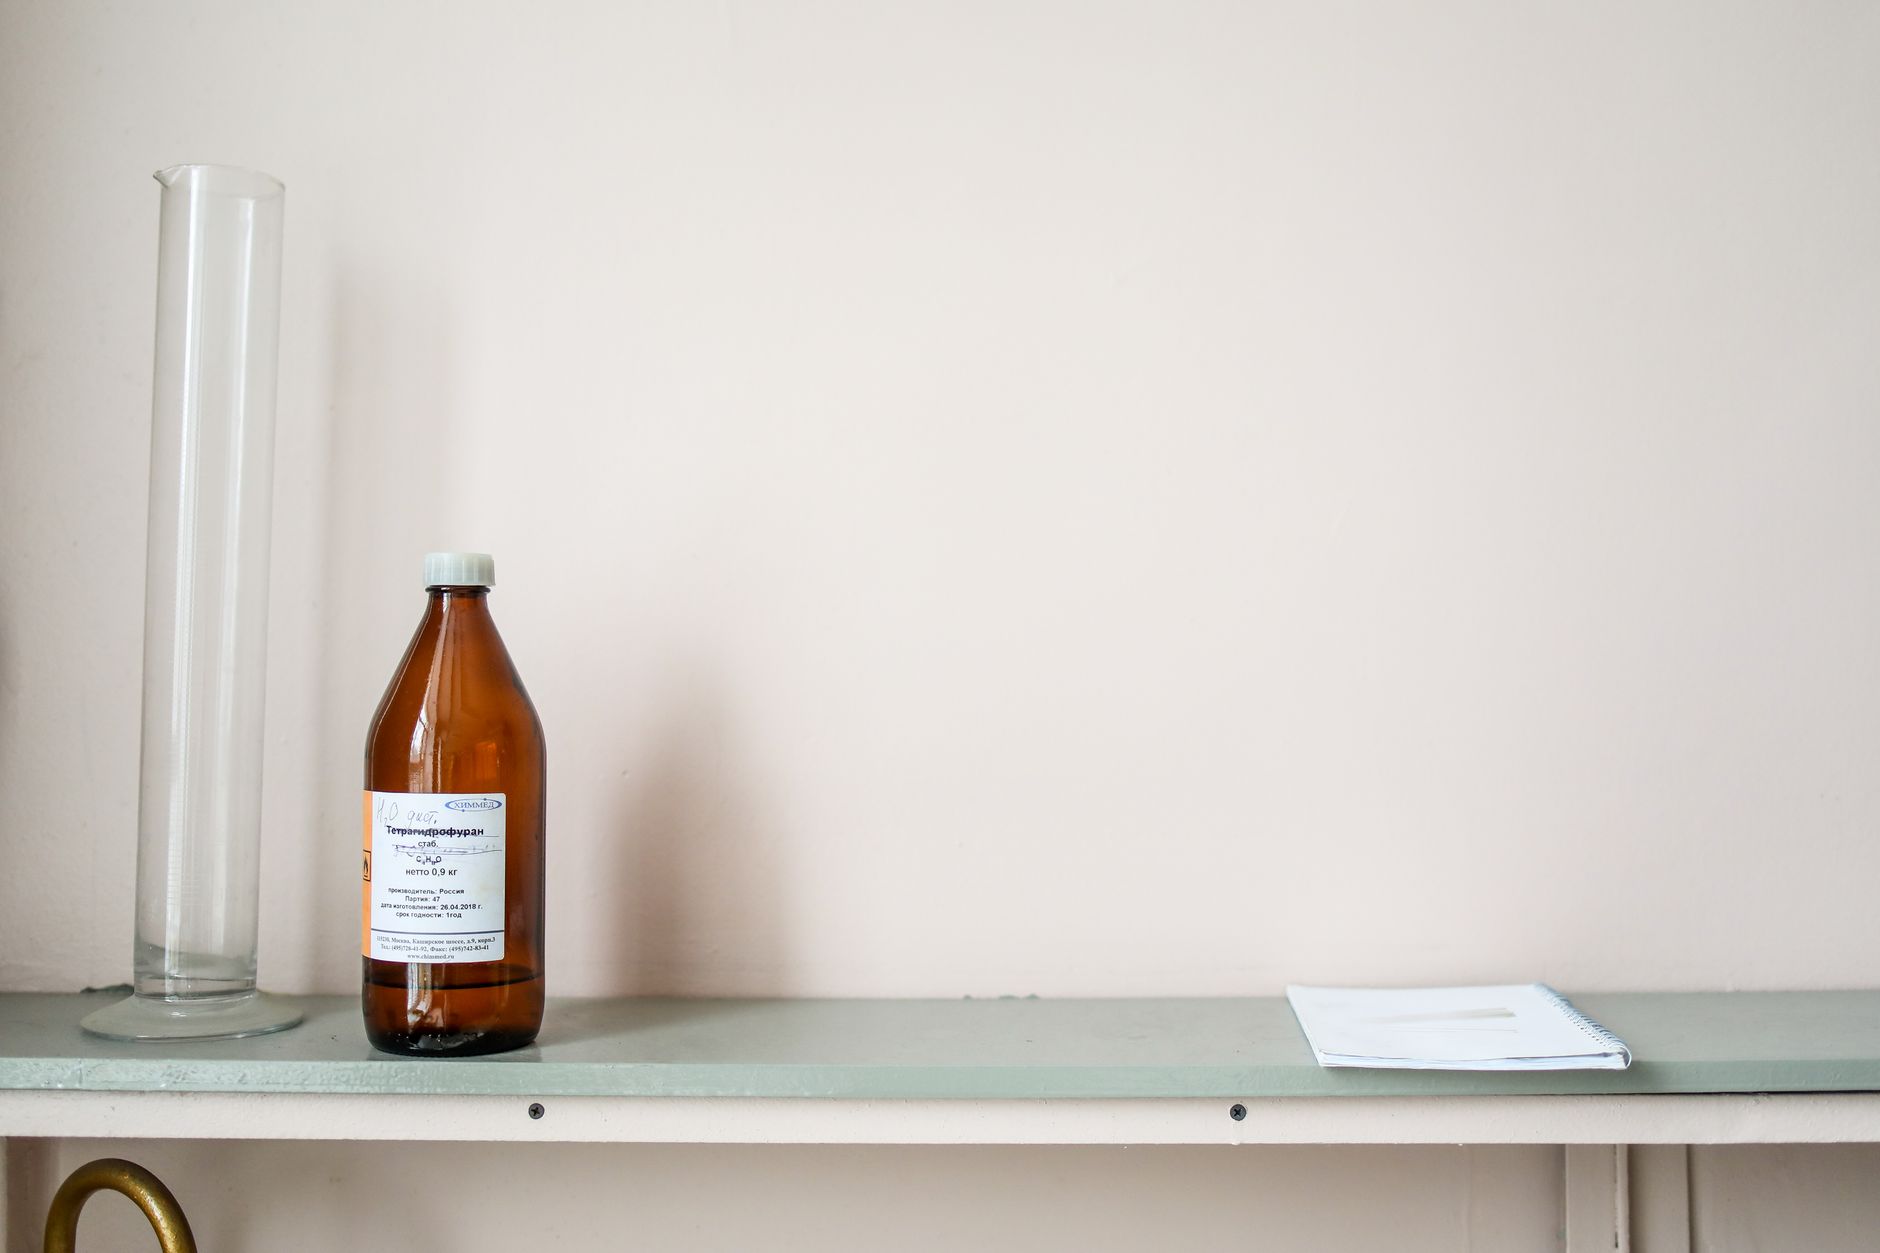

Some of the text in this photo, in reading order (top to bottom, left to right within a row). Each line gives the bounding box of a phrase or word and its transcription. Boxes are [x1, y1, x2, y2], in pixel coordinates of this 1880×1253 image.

[386, 825, 484, 837] Тетрагидрофуран
[418, 840, 438, 848] стаб.
[405, 868, 430, 876] нетто
[431, 868, 446, 877] 0,9
[388, 887, 438, 895] производитель:
[396, 912, 410, 920] срок
